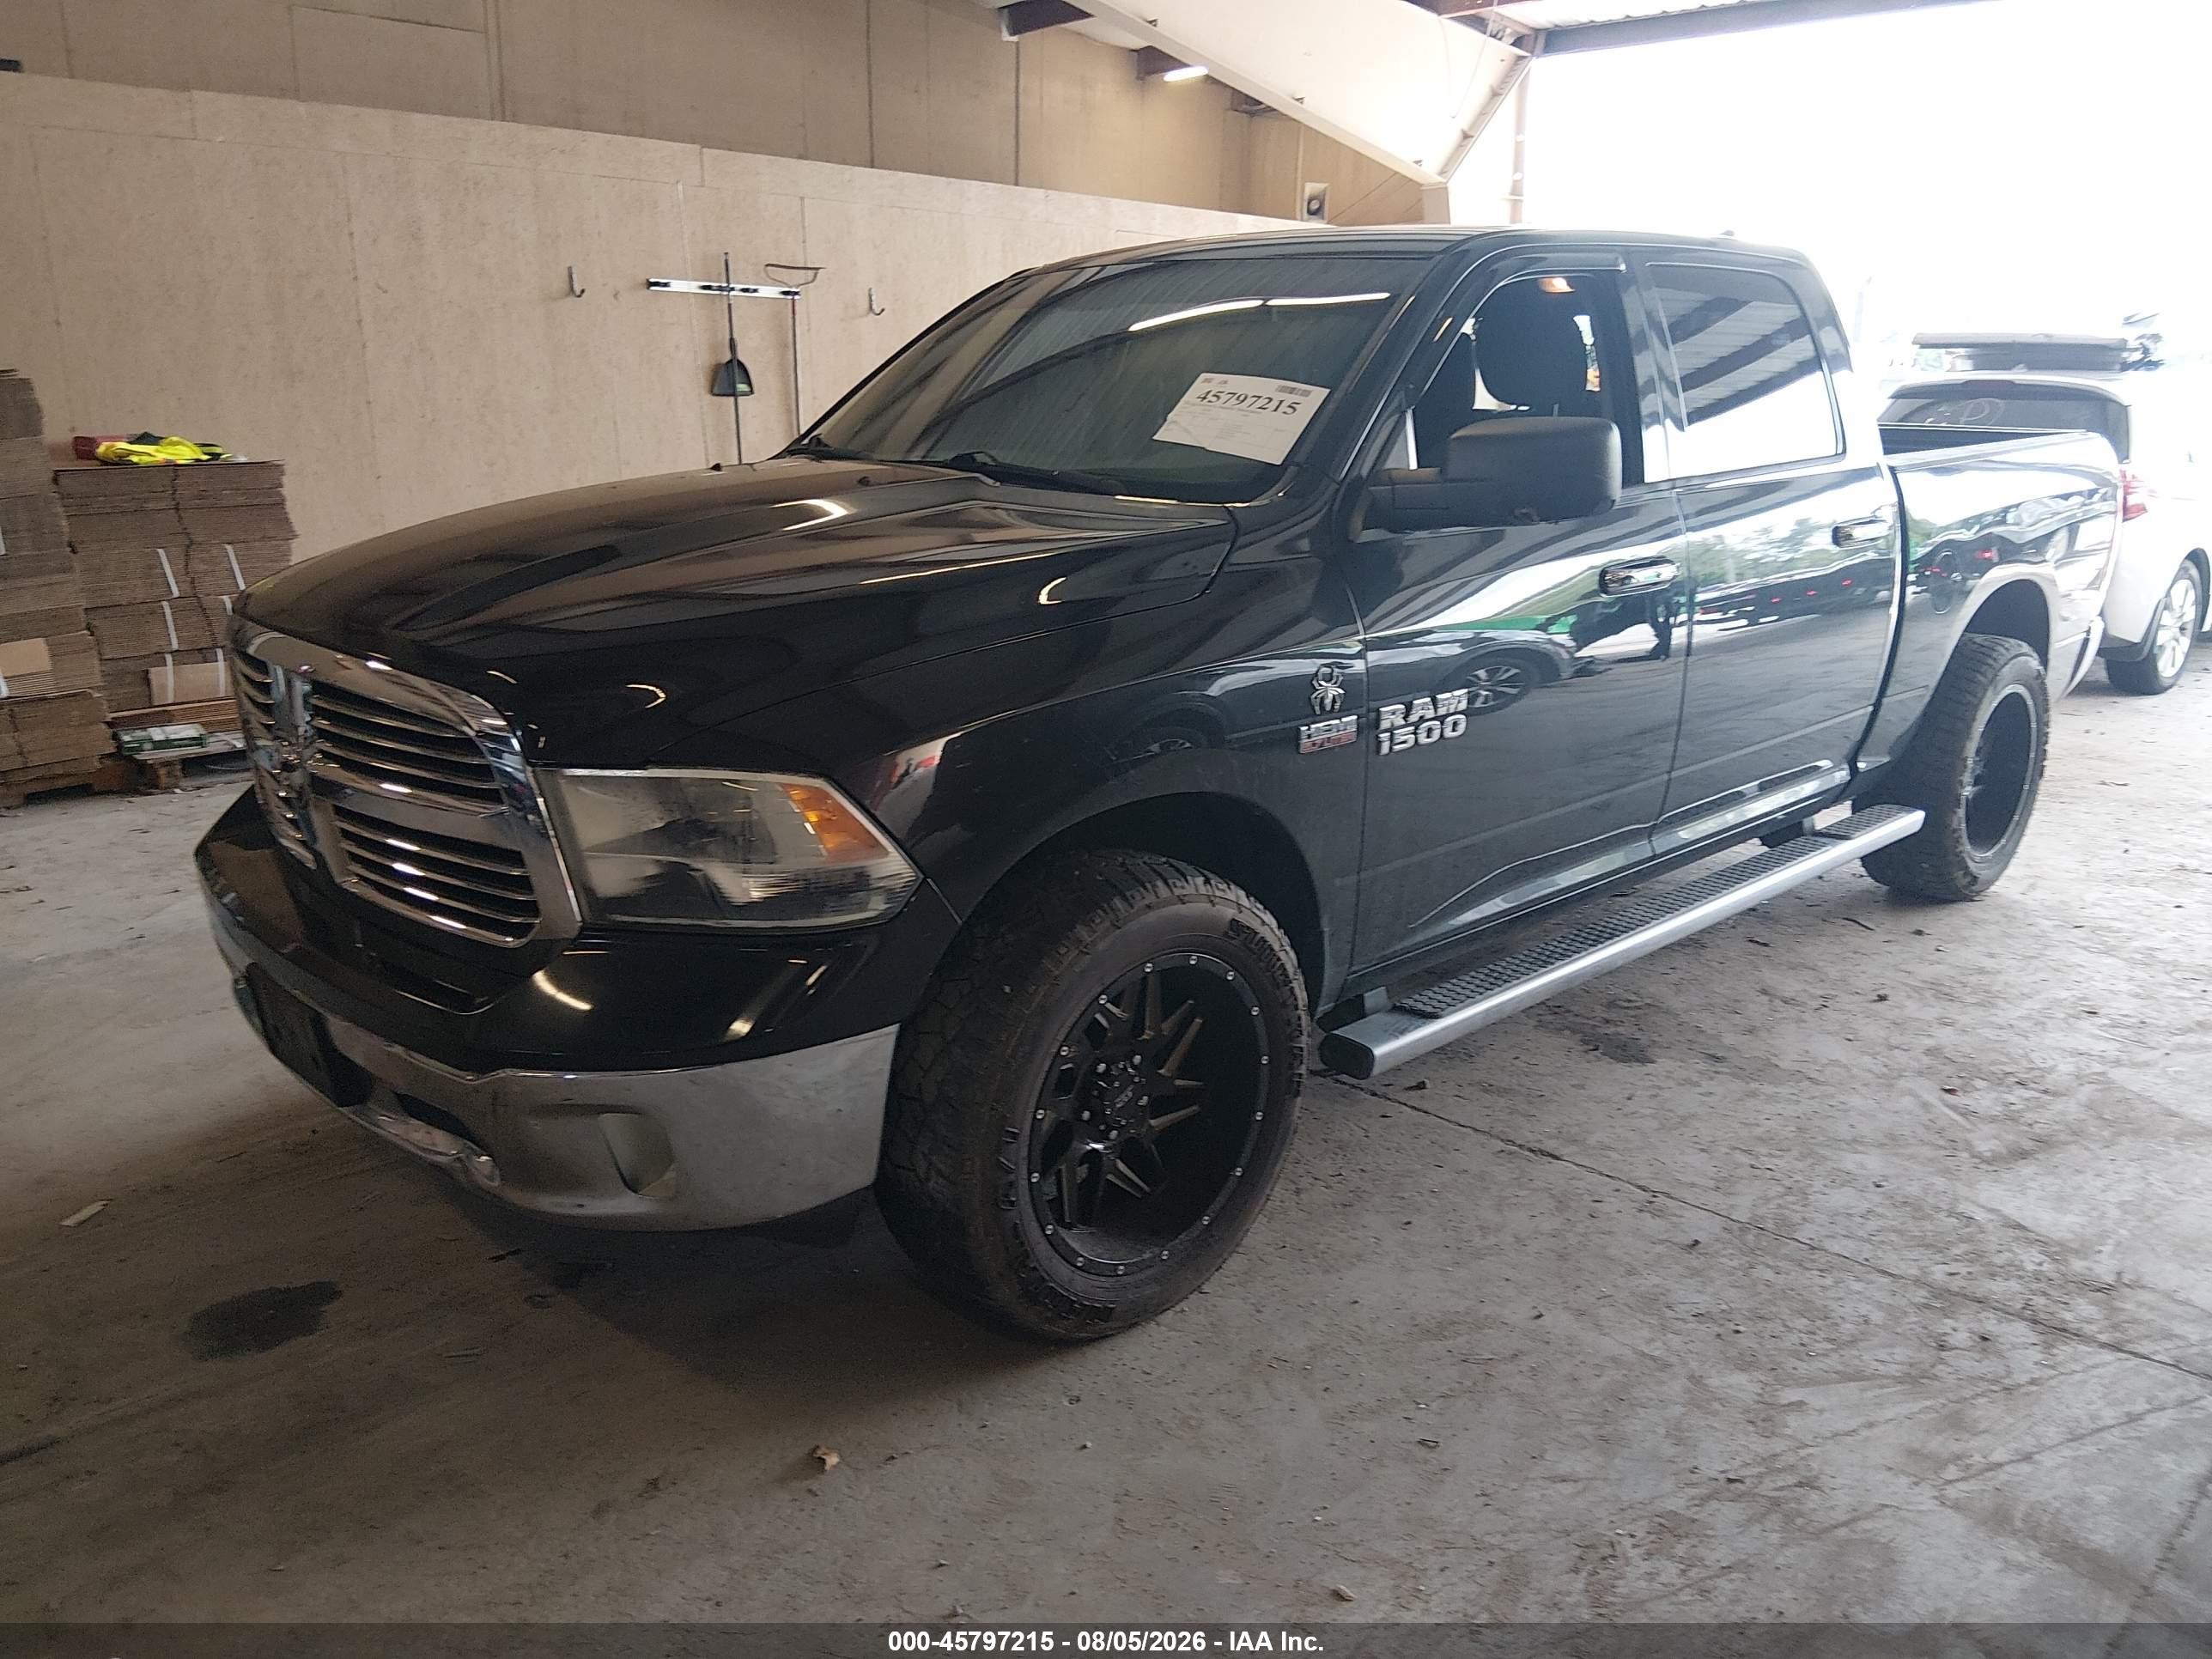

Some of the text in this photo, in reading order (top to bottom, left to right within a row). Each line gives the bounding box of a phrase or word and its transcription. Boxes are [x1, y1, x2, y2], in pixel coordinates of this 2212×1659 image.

[1195, 389, 1301, 416] 45797215
[1379, 688, 1469, 730] RAM
[1377, 714, 1467, 756] 1500
